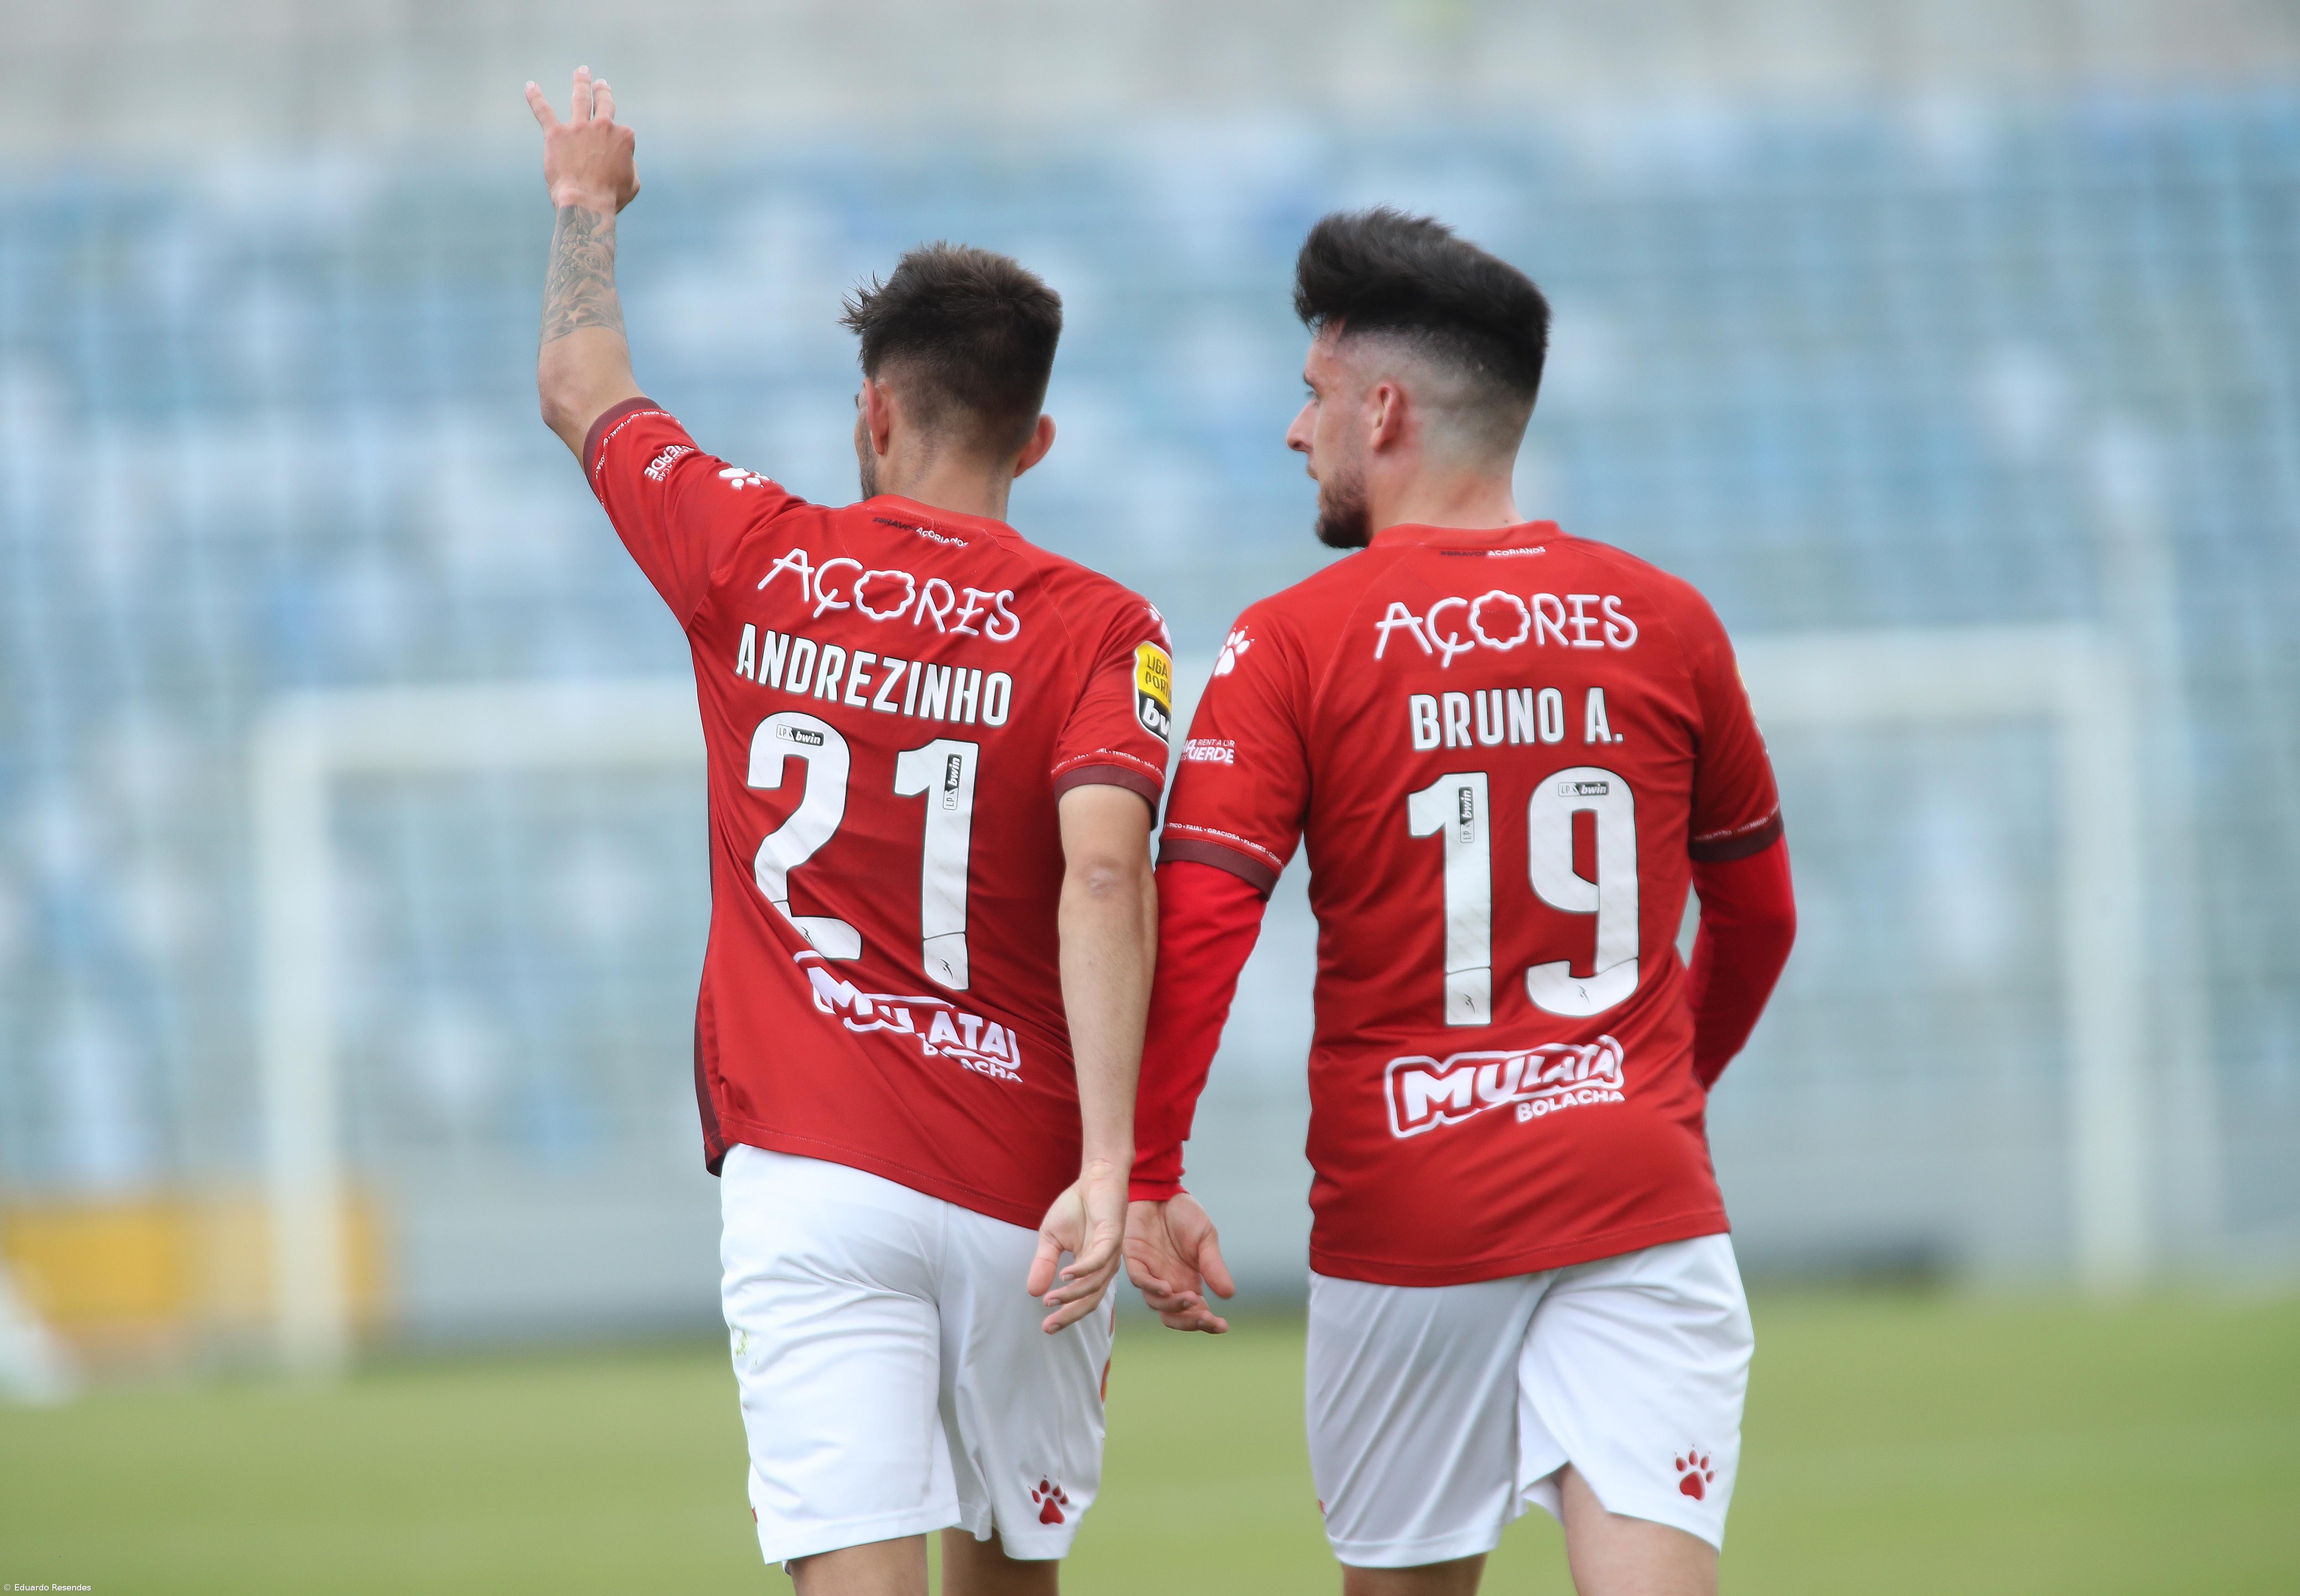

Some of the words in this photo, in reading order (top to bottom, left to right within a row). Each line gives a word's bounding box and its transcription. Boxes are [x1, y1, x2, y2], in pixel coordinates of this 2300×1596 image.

[610, 422, 625, 437] FAIAL
[656, 468, 670, 481] CAR
[757, 547, 1021, 641] AÇORES
[1375, 589, 1638, 668] AÇORES
[735, 622, 1013, 726] ANDREZINHO
[1146, 653, 1168, 679] LIGA
[1409, 688, 1566, 751] BRUNO
[1584, 688, 1624, 744] A.
[795, 730, 821, 745] bwin
[1113, 750, 1141, 763] TERCEIRA
[948, 757, 960, 787] bwin
[1581, 783, 1606, 794] bwin
[1461, 790, 1472, 819] bwin
[747, 711, 979, 991] 21
[1208, 828, 1240, 841] GRACIOSA
[1244, 839, 1267, 853] FLORES
[1408, 766, 1640, 1027] 19
[1404, 1043, 1615, 1122] MULATA
[1516, 1089, 1626, 1123] BOLACHA
